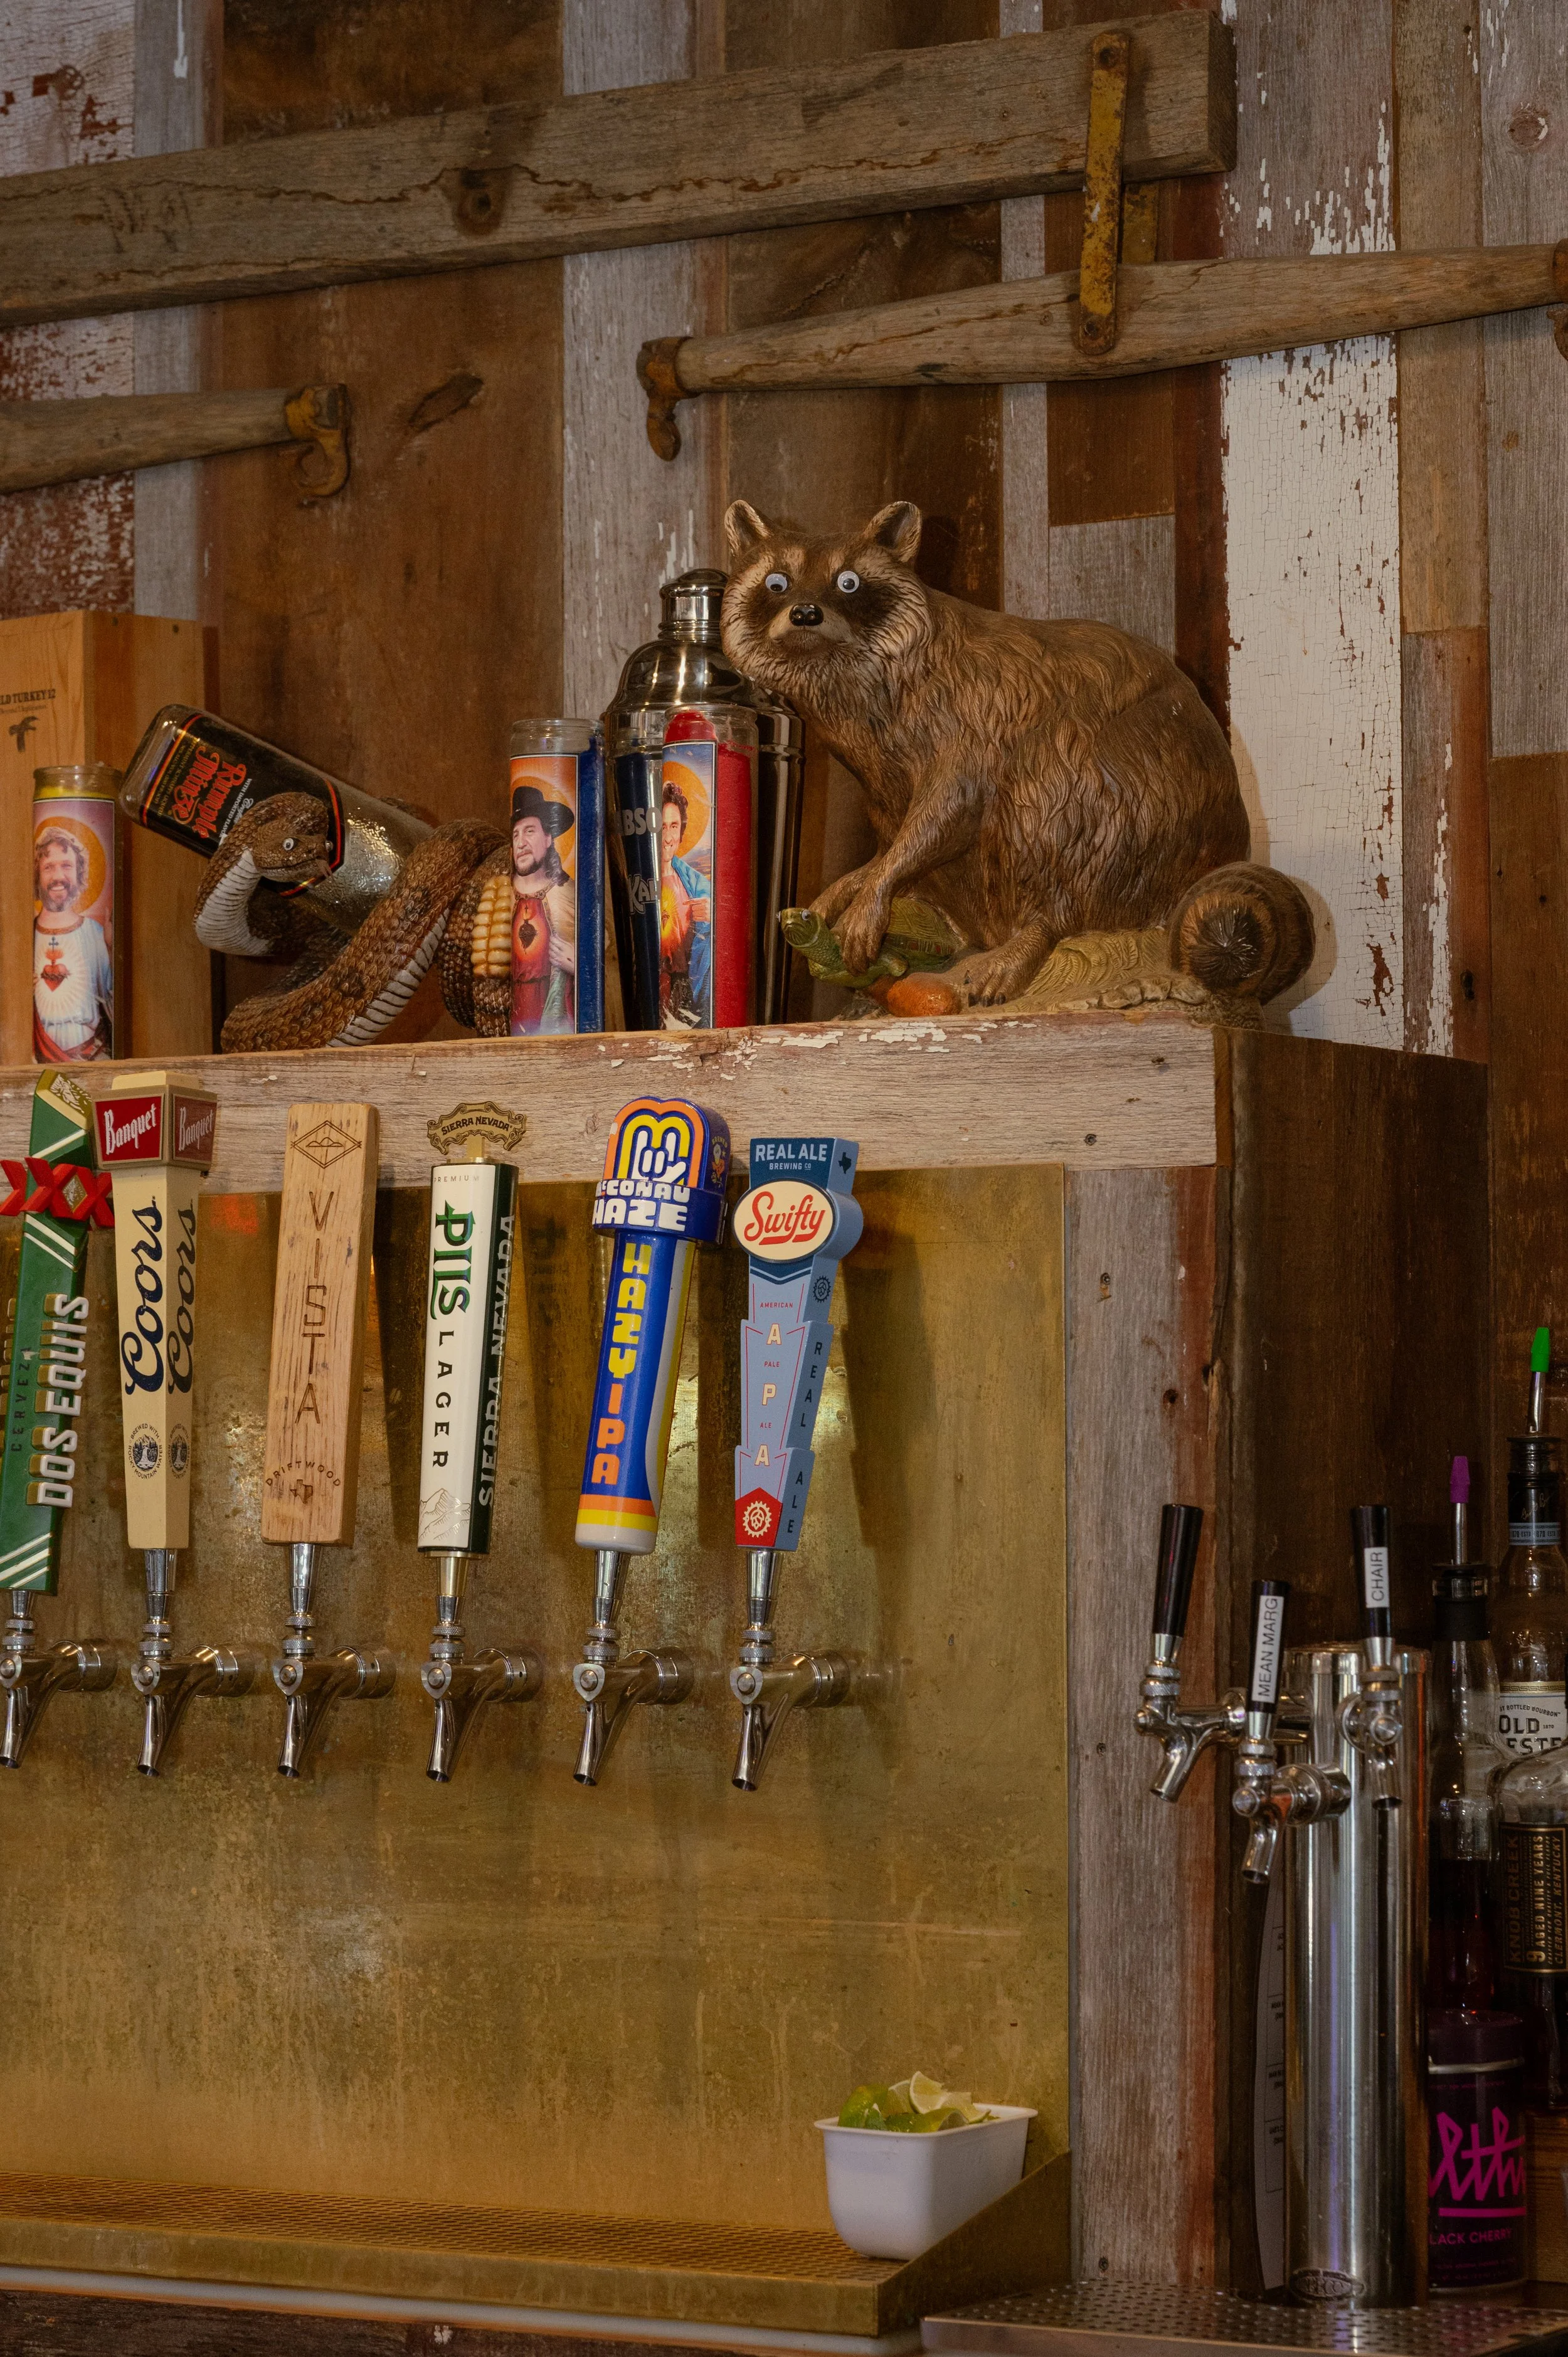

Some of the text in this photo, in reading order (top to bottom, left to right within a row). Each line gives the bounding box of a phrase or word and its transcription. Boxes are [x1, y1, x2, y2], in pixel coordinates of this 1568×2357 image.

[12, 690, 47, 702] TURKEY
[192, 761, 246, 838] Rumple
[228, 788, 245, 819] IMPORTED
[243, 778, 252, 790] WITH
[627, 874, 662, 916] KAH
[104, 1103, 157, 1155] Banquet
[178, 1106, 214, 1152] Banquet
[441, 1115, 511, 1135] SIERRA NEVADA
[755, 1143, 828, 1162] REAL ALE
[769, 1162, 803, 1170] BREWING
[591, 1197, 689, 1232] HAZE
[744, 1190, 826, 1246] Swifty
[430, 1199, 476, 1320] PILS
[120, 1197, 164, 1396] Coors
[167, 1199, 196, 1395] Coors
[294, 1190, 334, 1424] VISTA
[607, 1242, 652, 1379] HAZY
[29, 1293, 89, 1508] DOS EQUIS
[432, 1330, 455, 1468] LAGER
[800, 1341, 823, 1427] REAL
[130, 1423, 160, 1439] BREWED WITH
[591, 1382, 626, 1486] IPA
[134, 1468, 157, 1480] MOUNTAIN
[265, 1460, 341, 1488] DRIFTWOOD
[787, 1471, 803, 1533] ALE
[1370, 1551, 1385, 1601] CHAIR
[1258, 1597, 1278, 1697] MEAN MARG
[1498, 1714, 1540, 1734] OLD
[1532, 1836, 1544, 1875] YEARS
[1507, 1835, 1521, 1962] KNOB CREEK
[1534, 1880, 1545, 1910] NINE
[1552, 1835, 1564, 1965] CLERMONT, KENTUCKY
[1534, 1915, 1546, 1947] AGED
[1526, 1950, 1546, 1963] 9
[1429, 2227, 1513, 2246] LACK CHERRY
